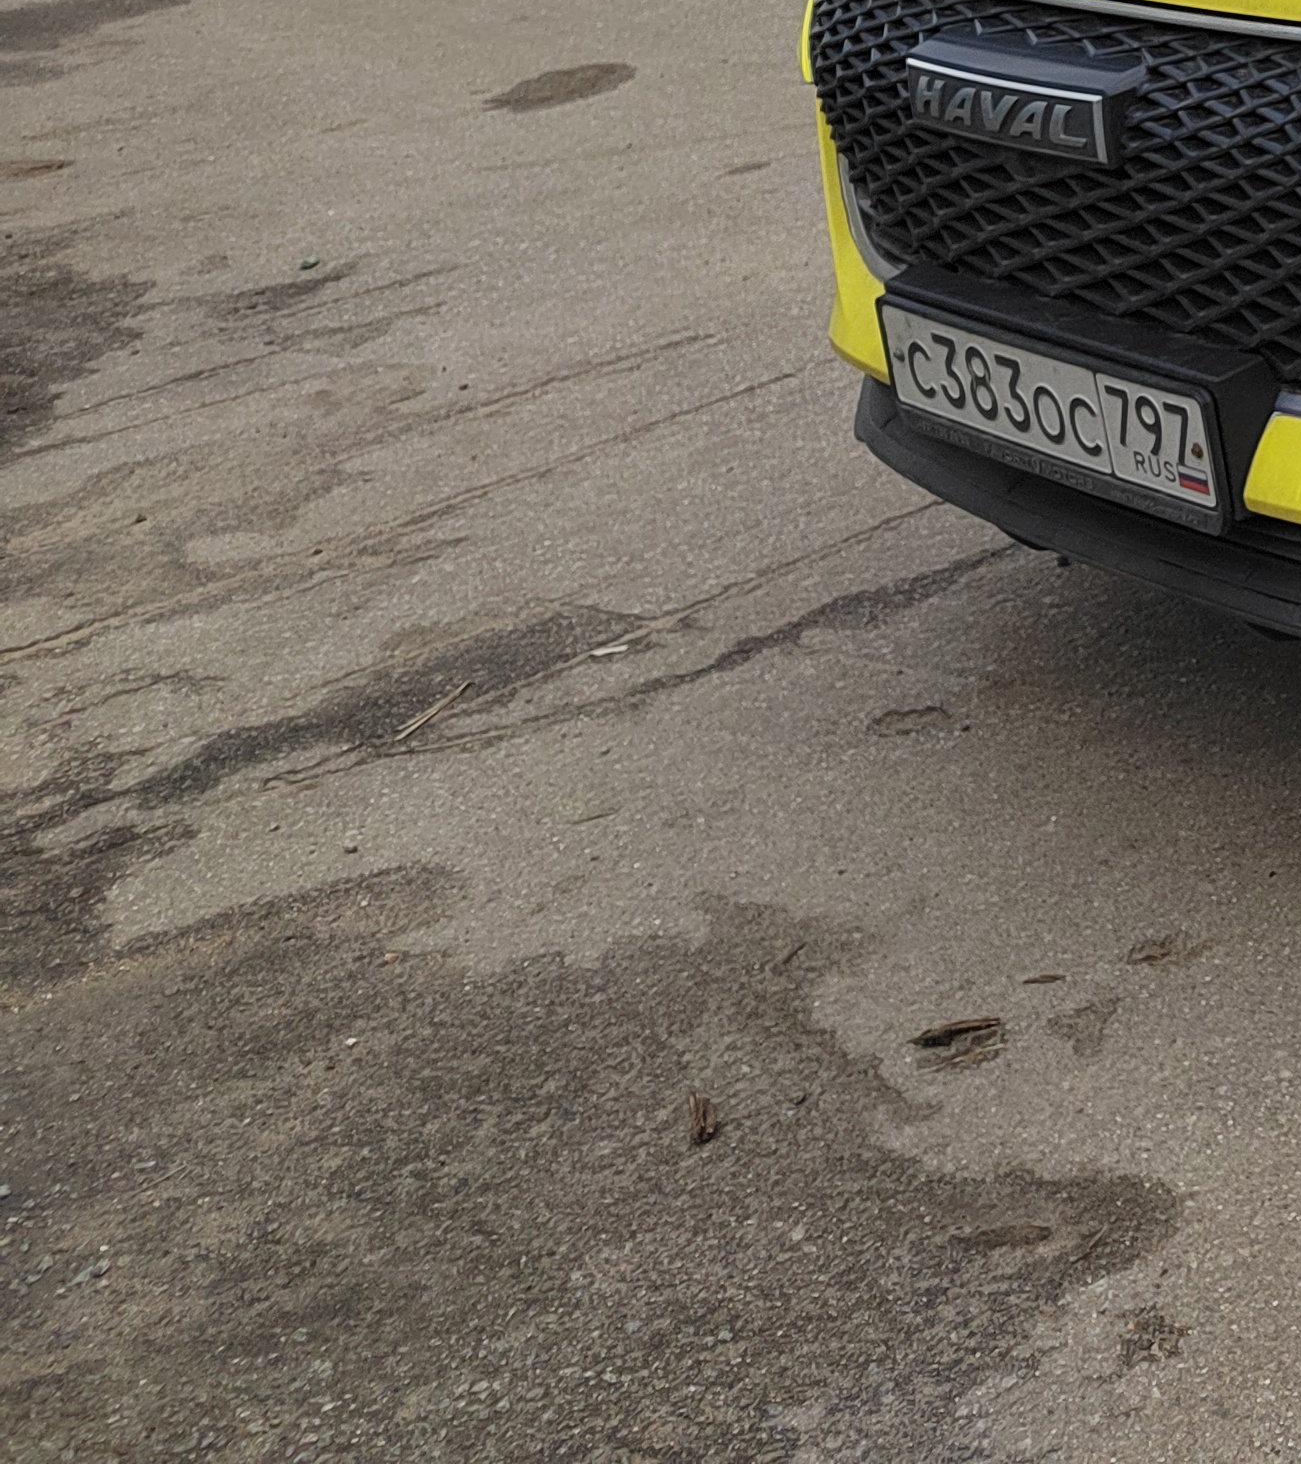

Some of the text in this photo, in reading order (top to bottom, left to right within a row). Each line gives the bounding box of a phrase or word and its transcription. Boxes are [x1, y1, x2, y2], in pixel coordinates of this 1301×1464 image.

[914, 75, 1088, 148] HAVAL
[907, 332, 1190, 466] С383ОС 797
[1133, 450, 1177, 483] RUS
